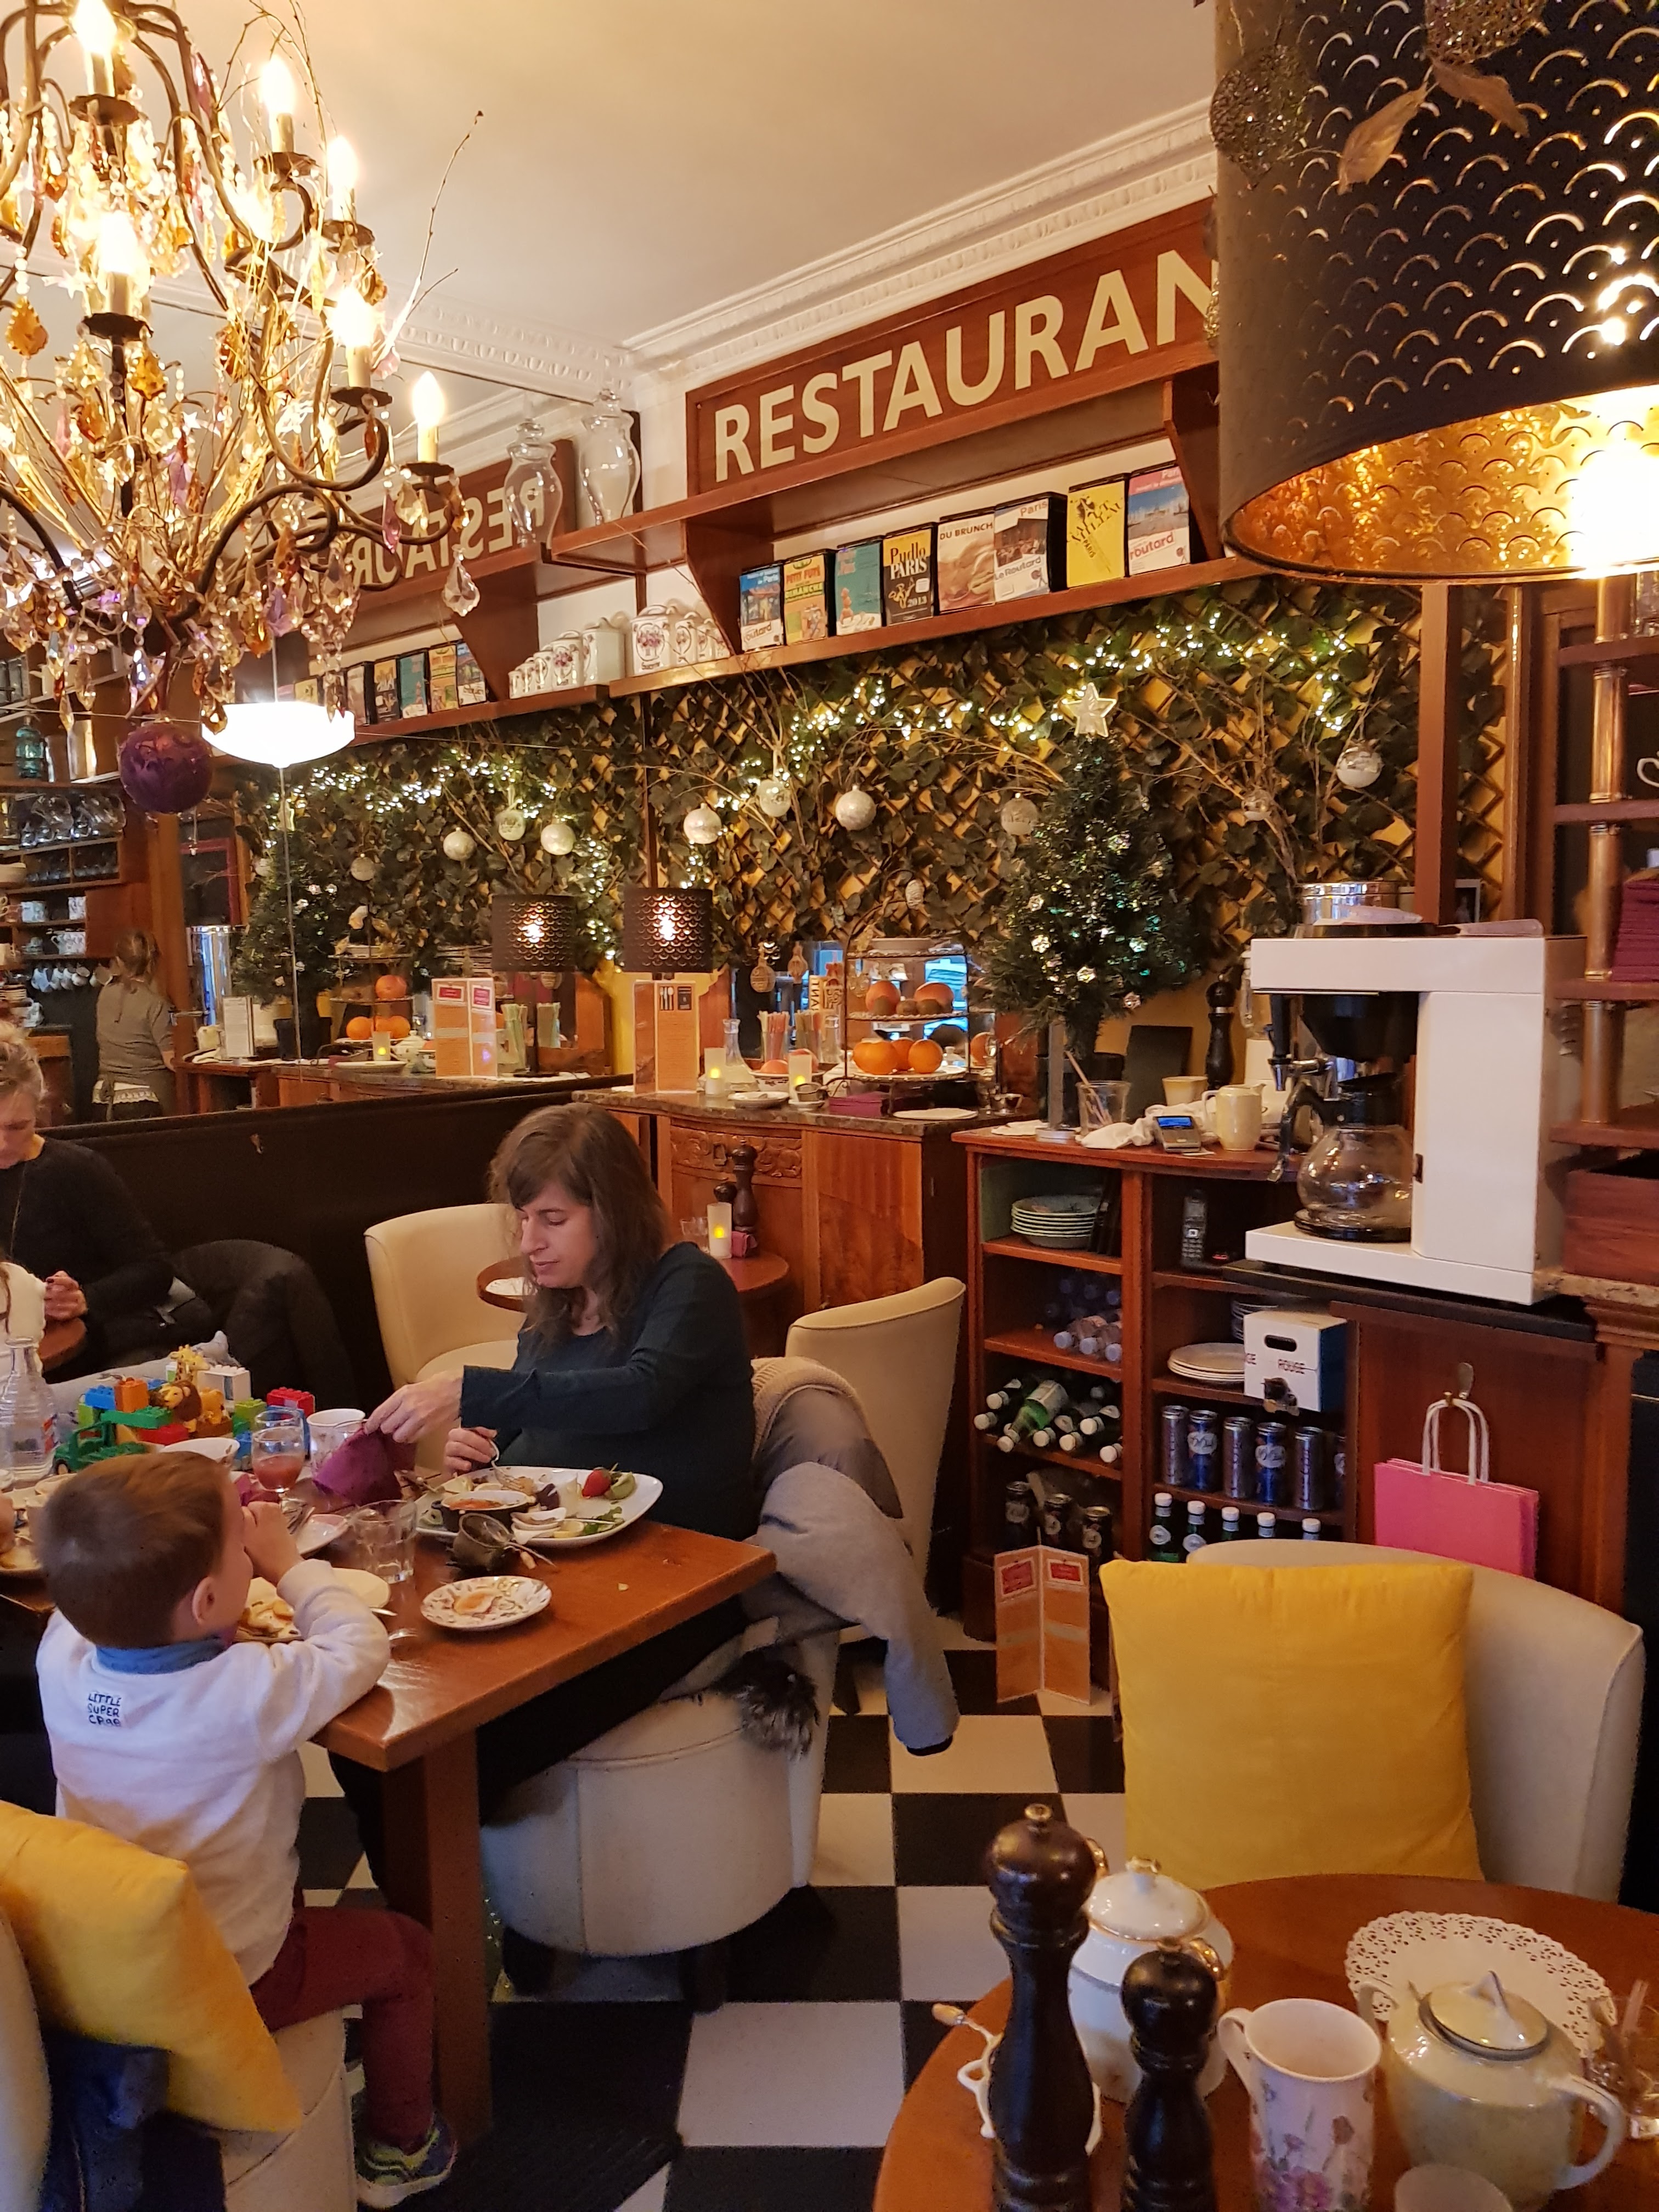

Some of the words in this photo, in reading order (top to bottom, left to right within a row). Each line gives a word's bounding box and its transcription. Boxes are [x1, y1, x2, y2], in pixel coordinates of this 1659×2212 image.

[1020, 501, 1047, 516] Paris
[940, 531, 952, 540] DU
[955, 522, 993, 537] BRUNCH
[890, 542, 926, 564] Pudlo
[1130, 532, 1174, 560] routard
[890, 557, 927, 580] PARIS
[1005, 556, 1041, 576] Routard
[906, 596, 927, 607] 2013
[88, 1693, 122, 1707] LITTLE
[88, 1703, 120, 1718] SUPER
